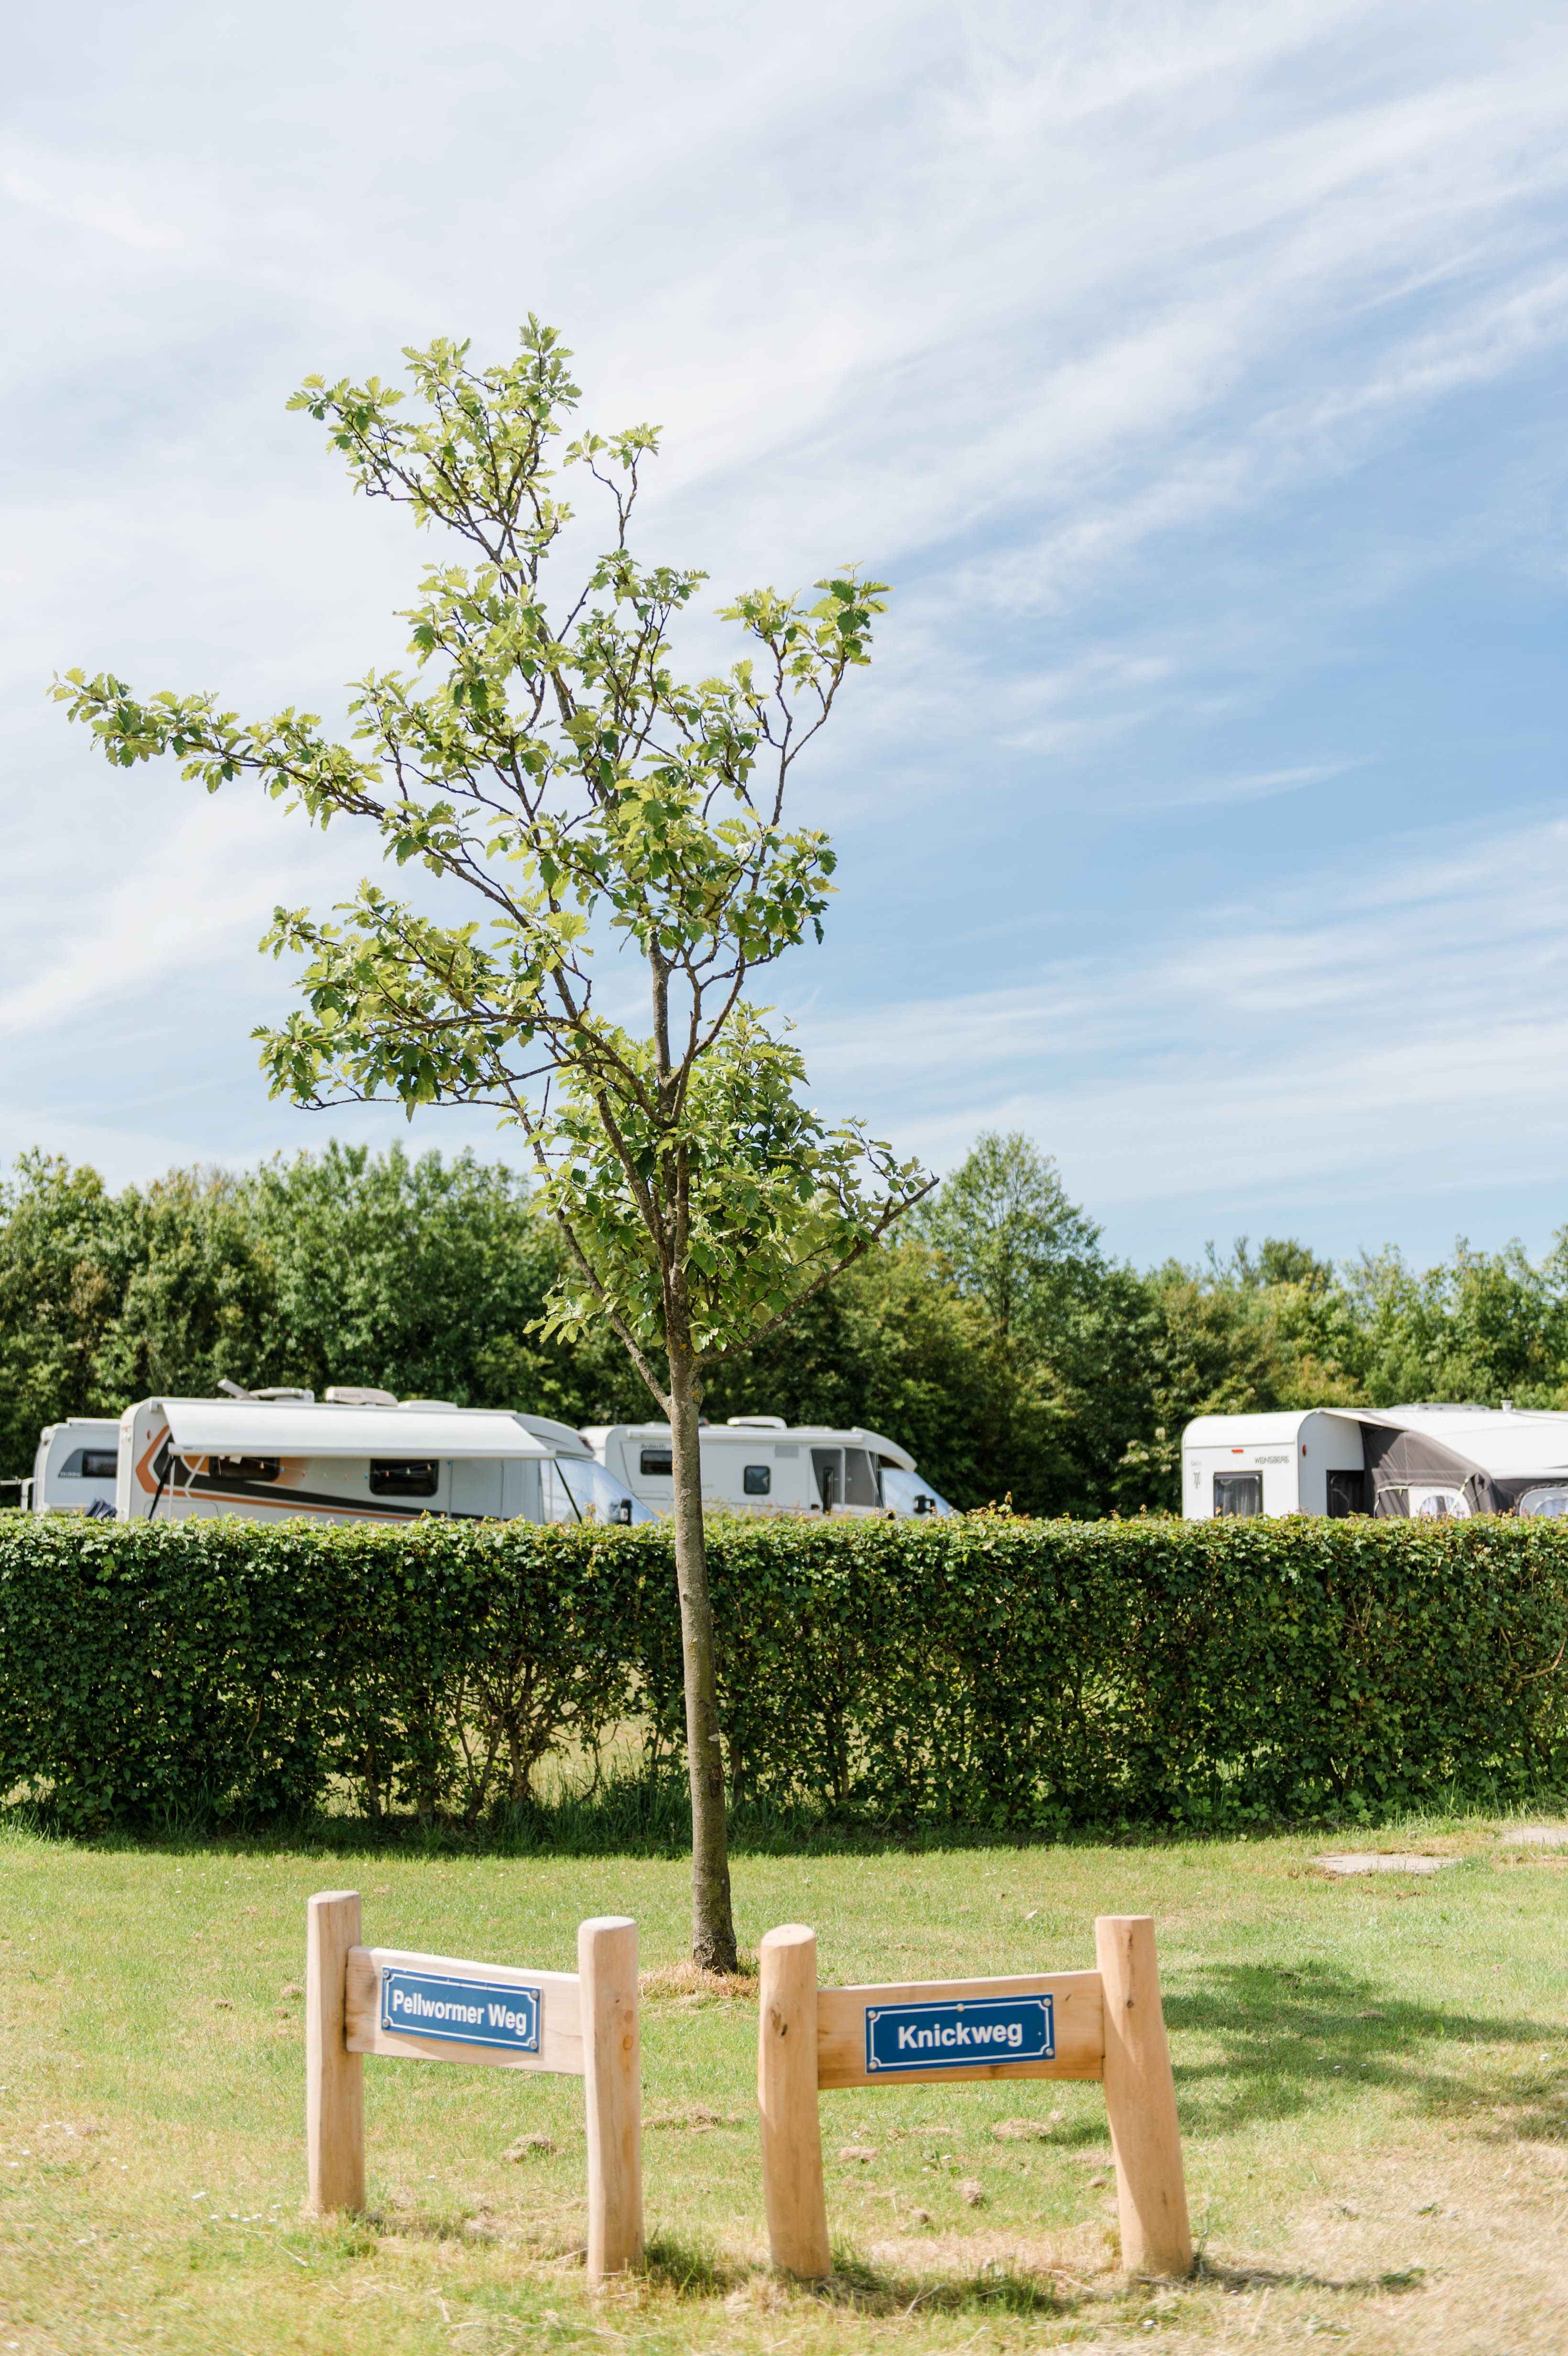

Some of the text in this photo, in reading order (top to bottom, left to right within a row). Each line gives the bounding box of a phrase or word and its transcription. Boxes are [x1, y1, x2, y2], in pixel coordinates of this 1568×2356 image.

[392, 1989, 526, 2036] Pellwormer Weg
[899, 2022, 1023, 2049] Knickweg
